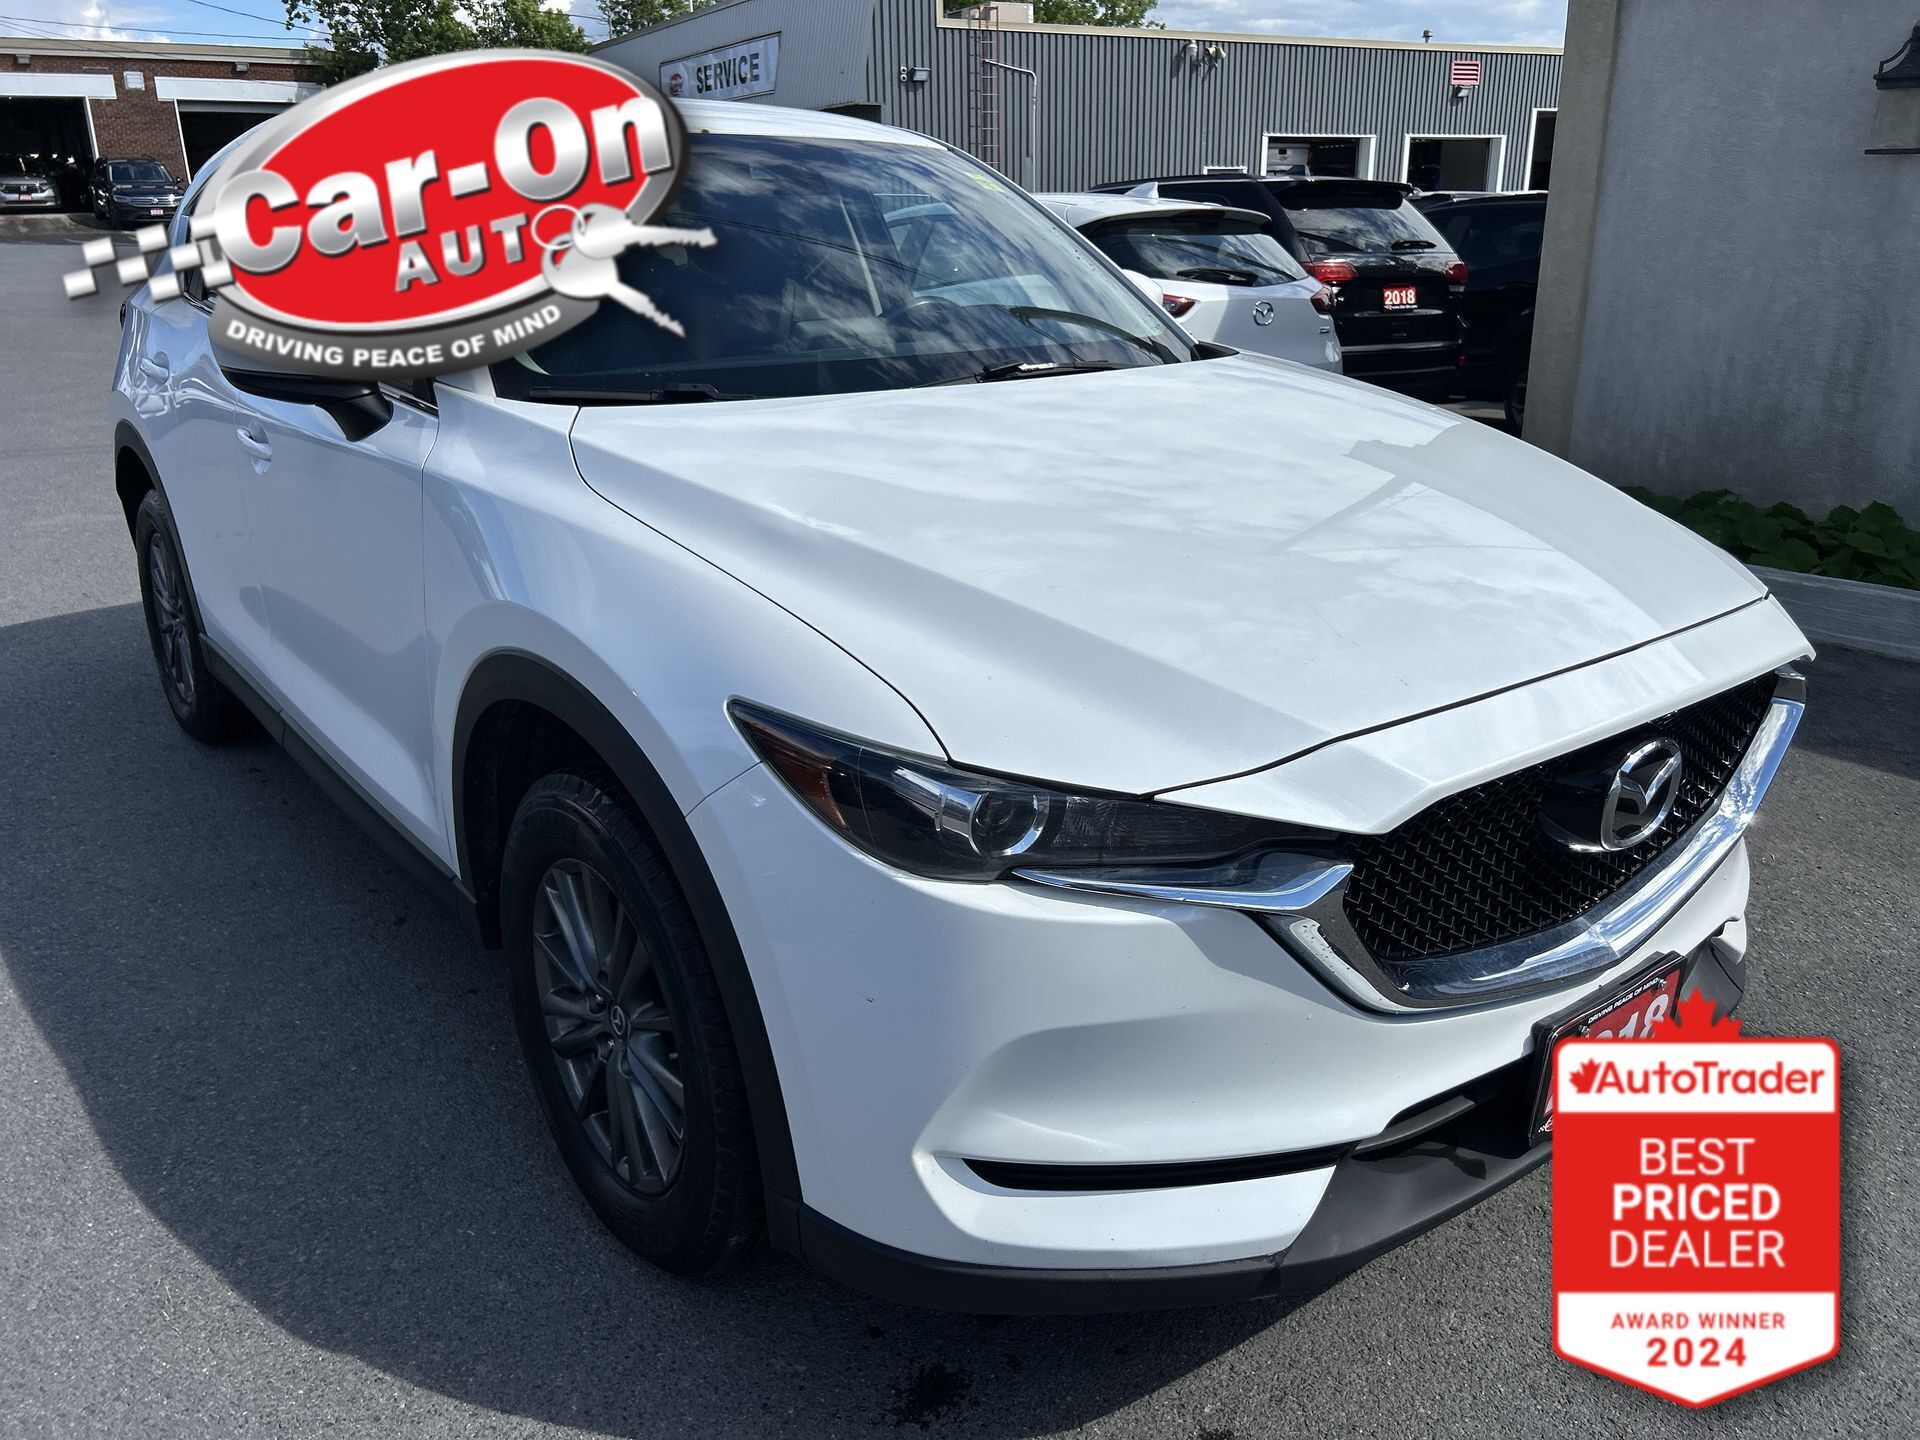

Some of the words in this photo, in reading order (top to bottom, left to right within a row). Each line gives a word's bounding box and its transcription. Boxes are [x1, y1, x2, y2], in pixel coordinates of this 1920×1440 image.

[696, 53, 760, 94] SERVICE
[1385, 290, 1415, 304] 2018
[1588, 1005, 1613, 1024] DRIVING
[1614, 993, 1634, 1008] PEACE
